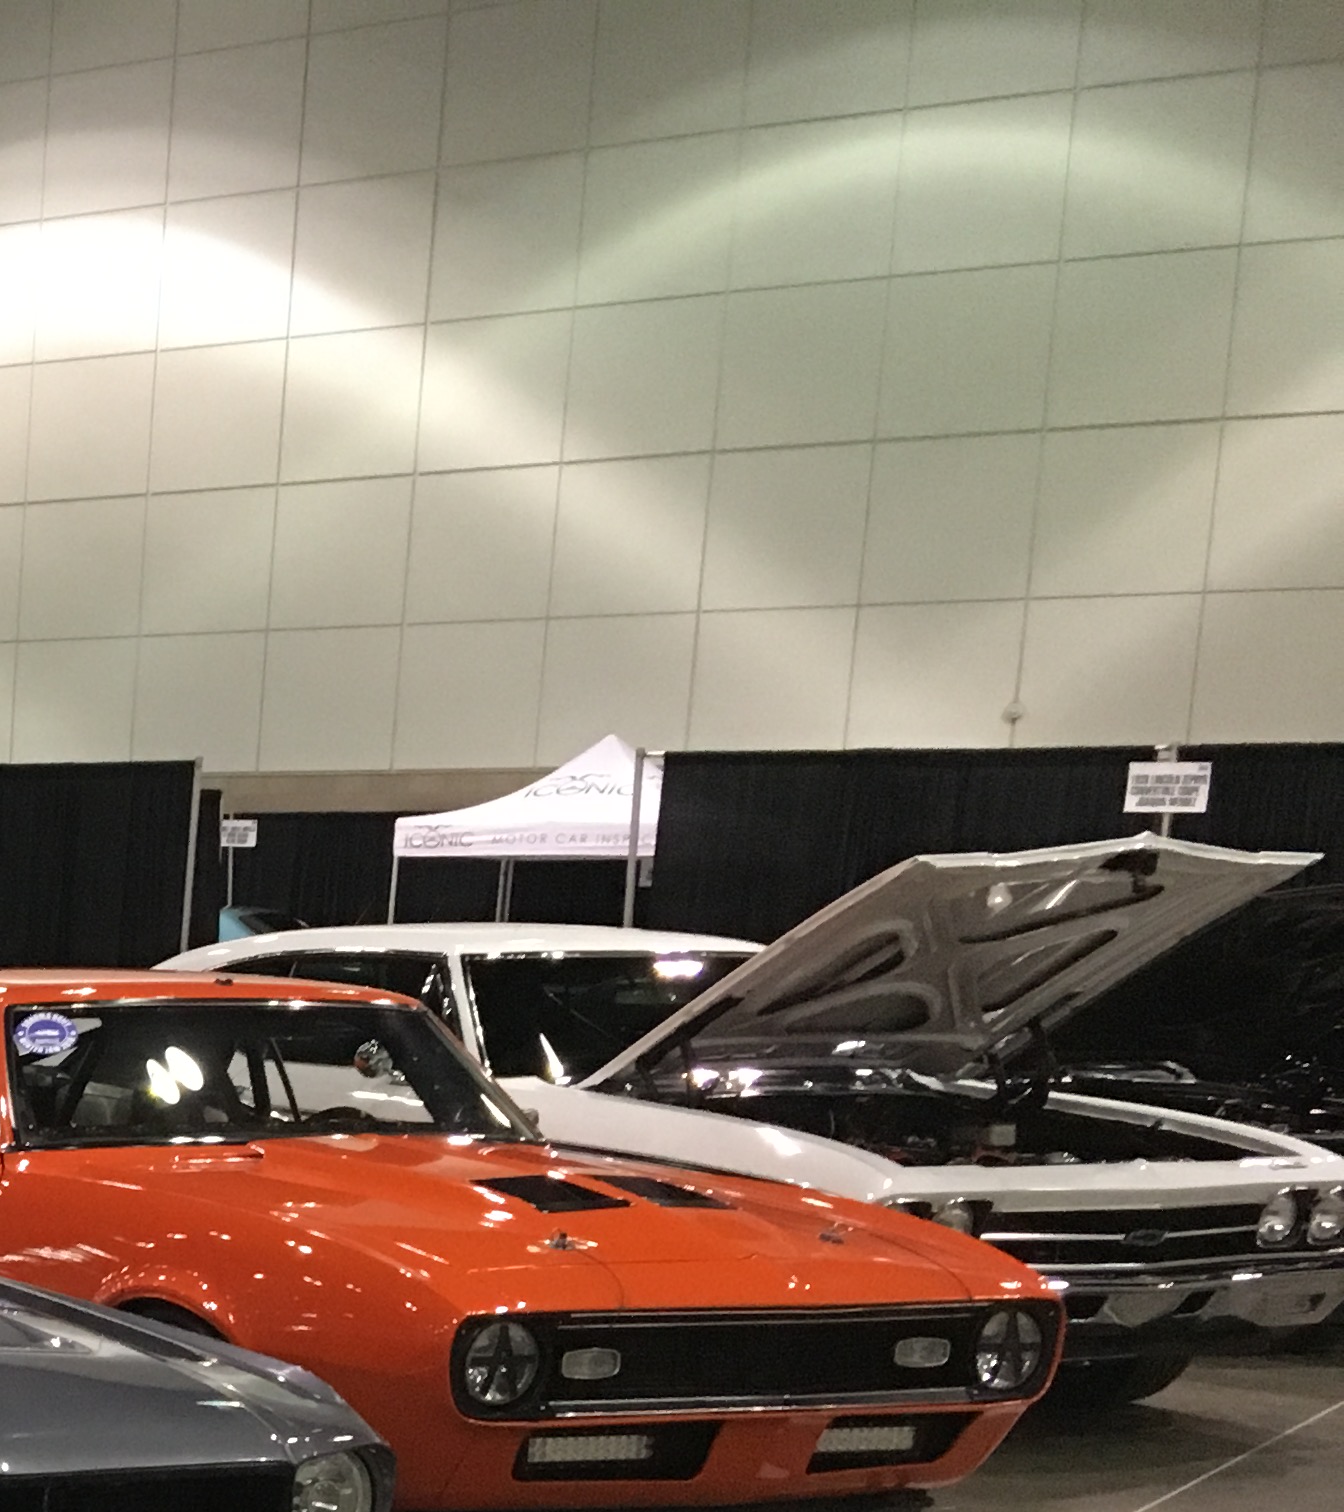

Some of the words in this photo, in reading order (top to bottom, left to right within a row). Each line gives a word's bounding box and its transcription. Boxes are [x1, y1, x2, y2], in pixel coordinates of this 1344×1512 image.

[524, 778, 634, 798] ICONIC
[404, 831, 475, 849] ICONIC
[491, 832, 548, 845] MOTOR
[555, 832, 588, 844] CAR
